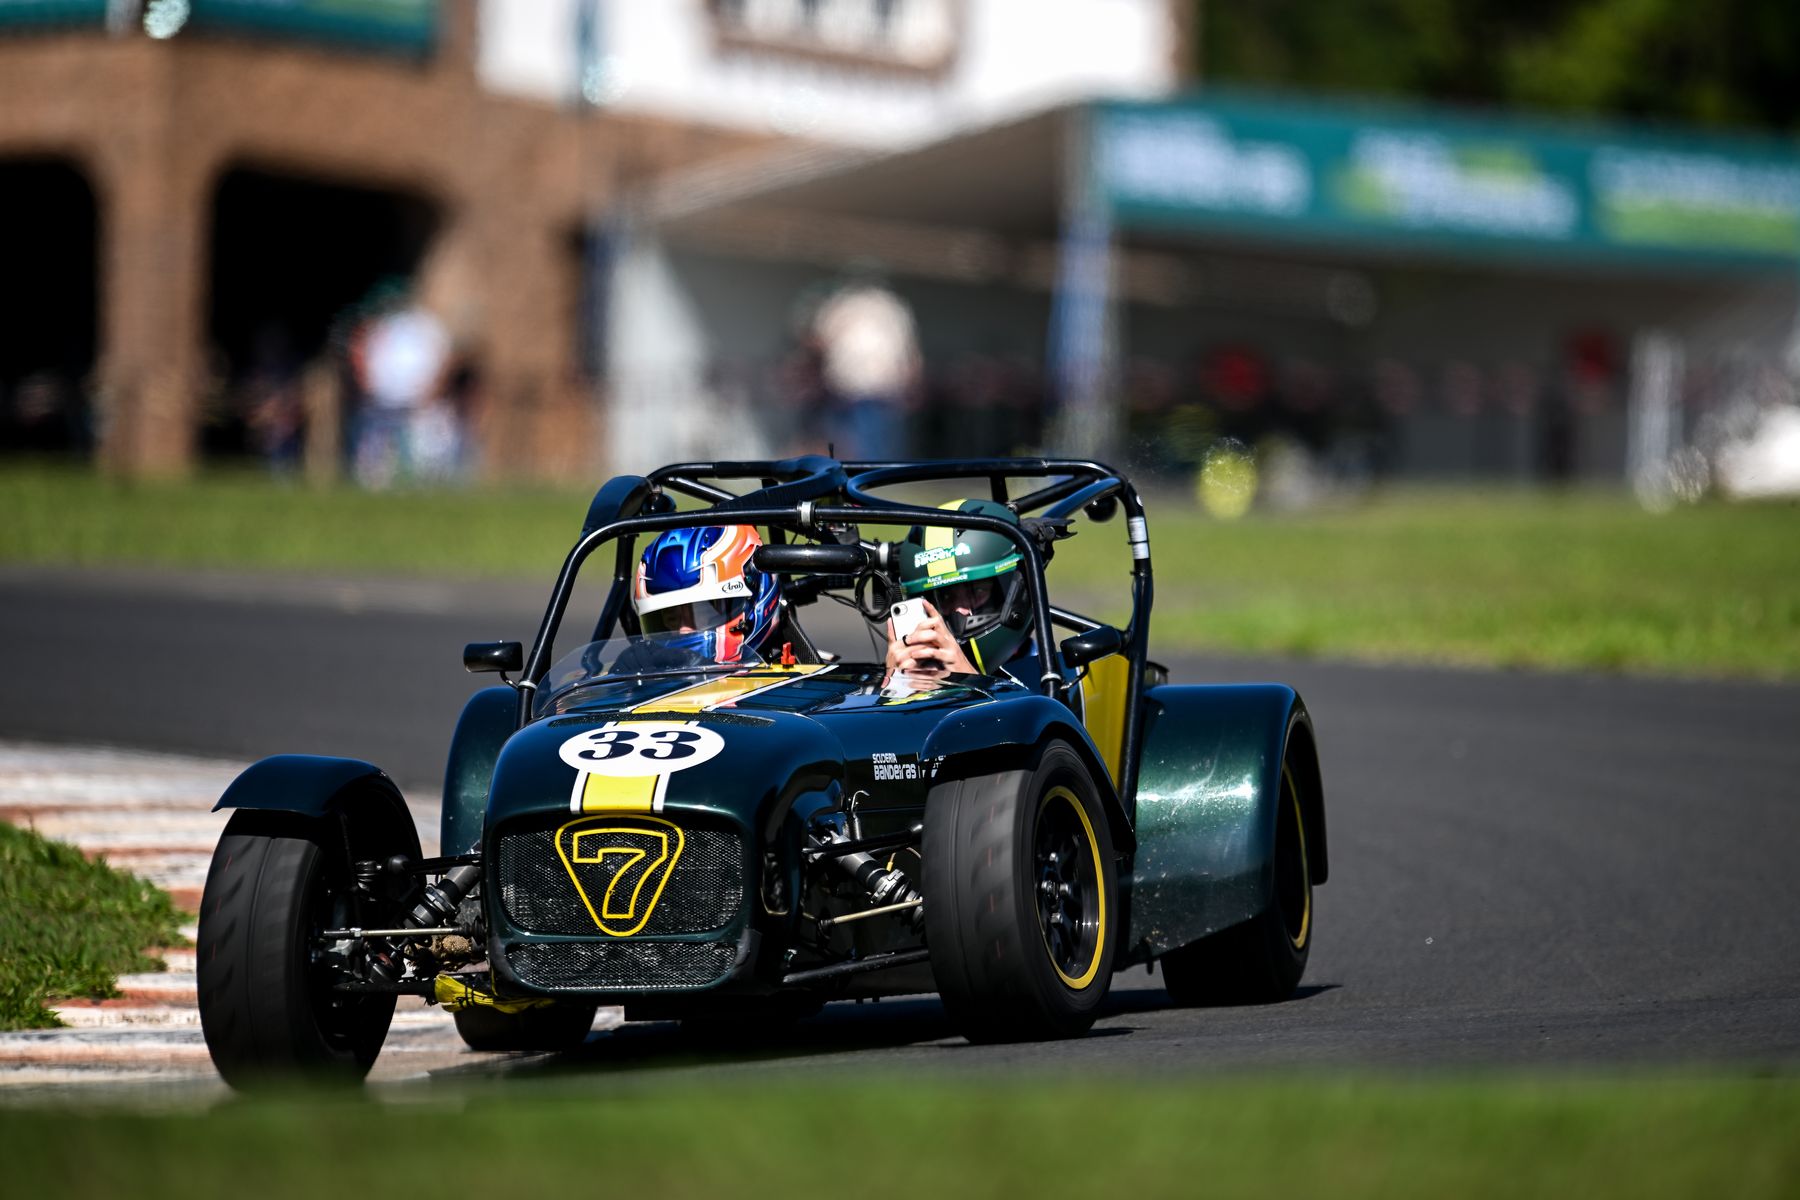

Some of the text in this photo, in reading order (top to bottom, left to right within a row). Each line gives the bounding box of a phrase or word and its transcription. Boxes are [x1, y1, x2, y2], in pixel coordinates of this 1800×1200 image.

[722, 581, 743, 592] Arai
[578, 730, 702, 760] 33
[572, 827, 668, 919] 7
